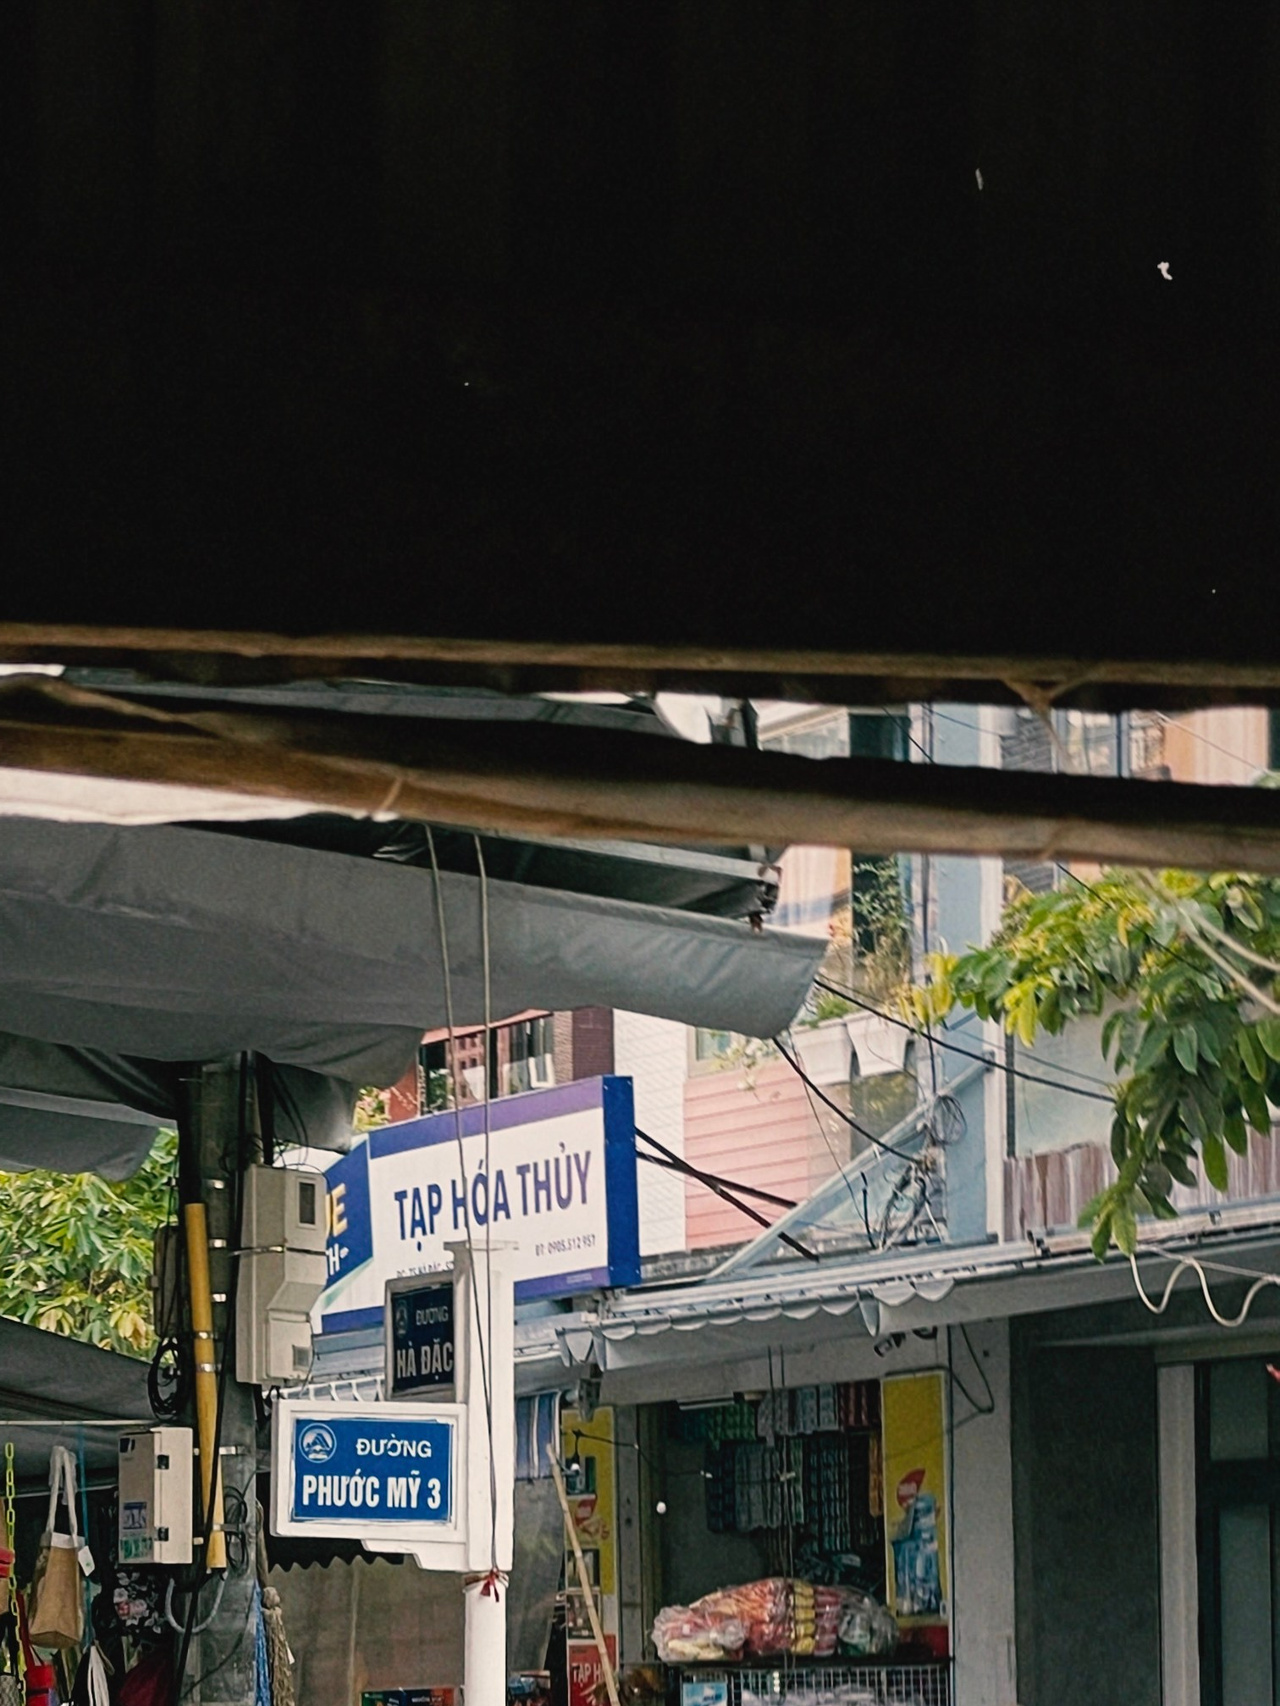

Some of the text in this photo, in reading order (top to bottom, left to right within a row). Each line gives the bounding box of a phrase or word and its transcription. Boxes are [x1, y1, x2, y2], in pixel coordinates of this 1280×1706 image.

[394, 1143, 592, 1252] TẠP HÓA THỦY
[396, 1341, 417, 1378] HÀ
[355, 1434, 432, 1458] ĐƯỜNG
[302, 1468, 441, 1510] PHƯỚC MỸ 3
